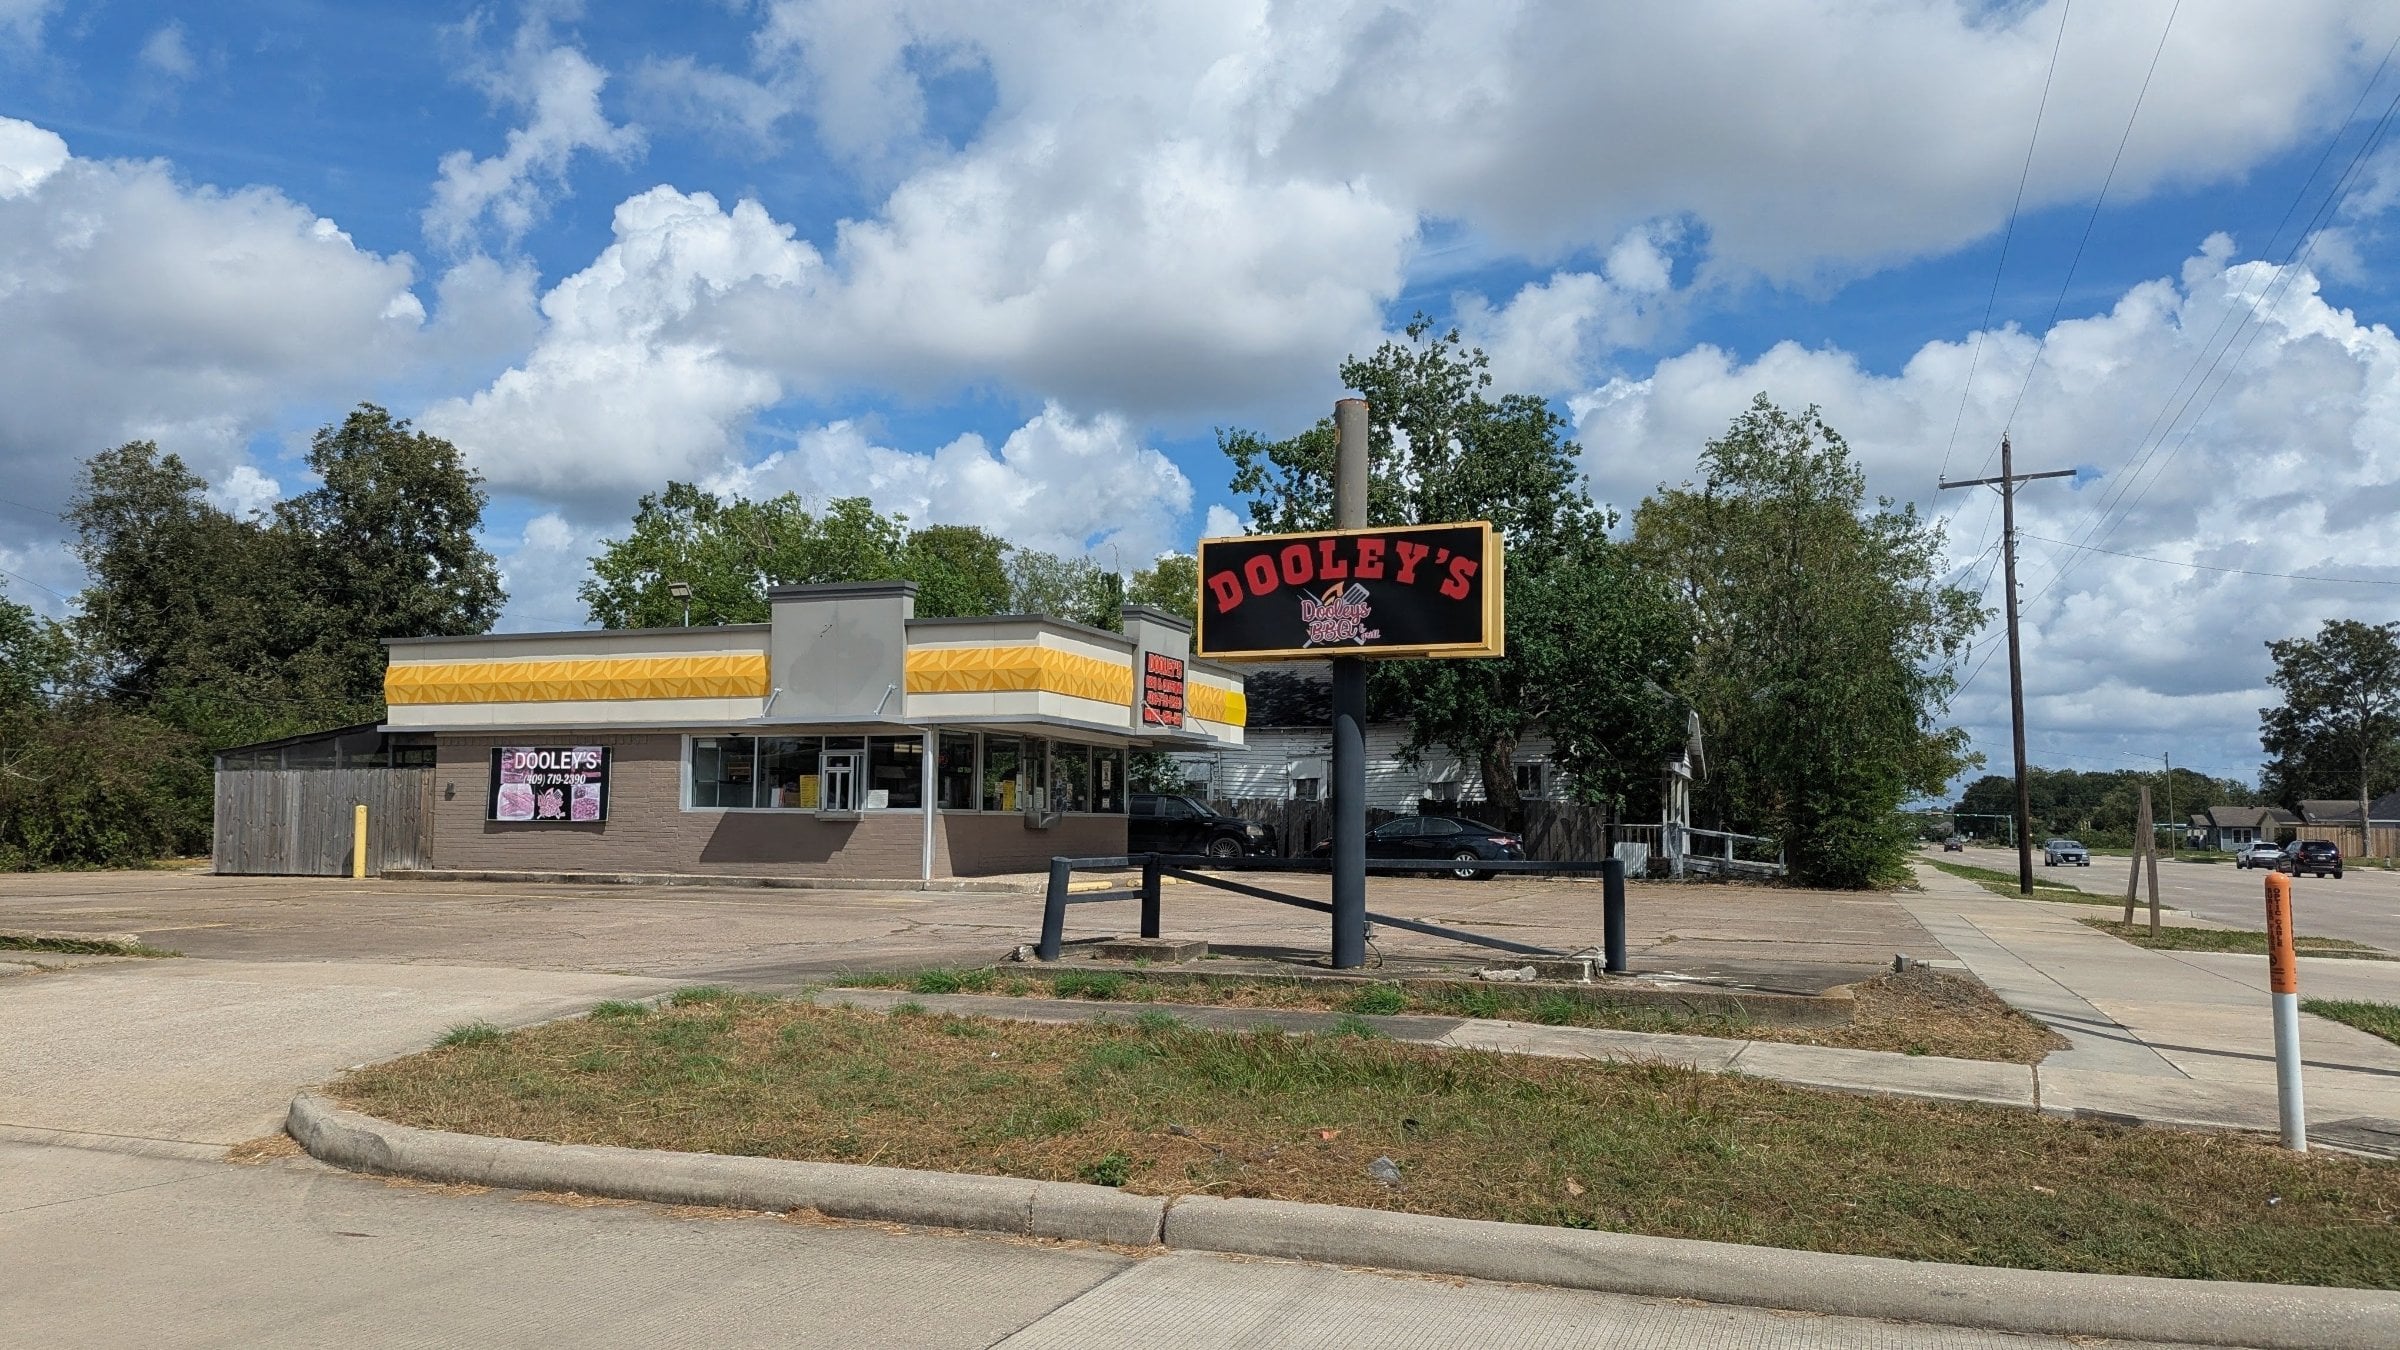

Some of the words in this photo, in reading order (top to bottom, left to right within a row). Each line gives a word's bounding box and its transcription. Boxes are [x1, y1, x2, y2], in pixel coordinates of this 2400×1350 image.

[1208, 538, 1478, 614] DOOLEY'S
[1301, 598, 1371, 625] Dooleys
[1309, 619, 1358, 642] BBQ
[514, 751, 598, 769] DOOLEY'S
[523, 774, 546, 787] (409)
[547, 774, 586, 785] 719-2390
[2273, 888, 2281, 916] OPTIC
